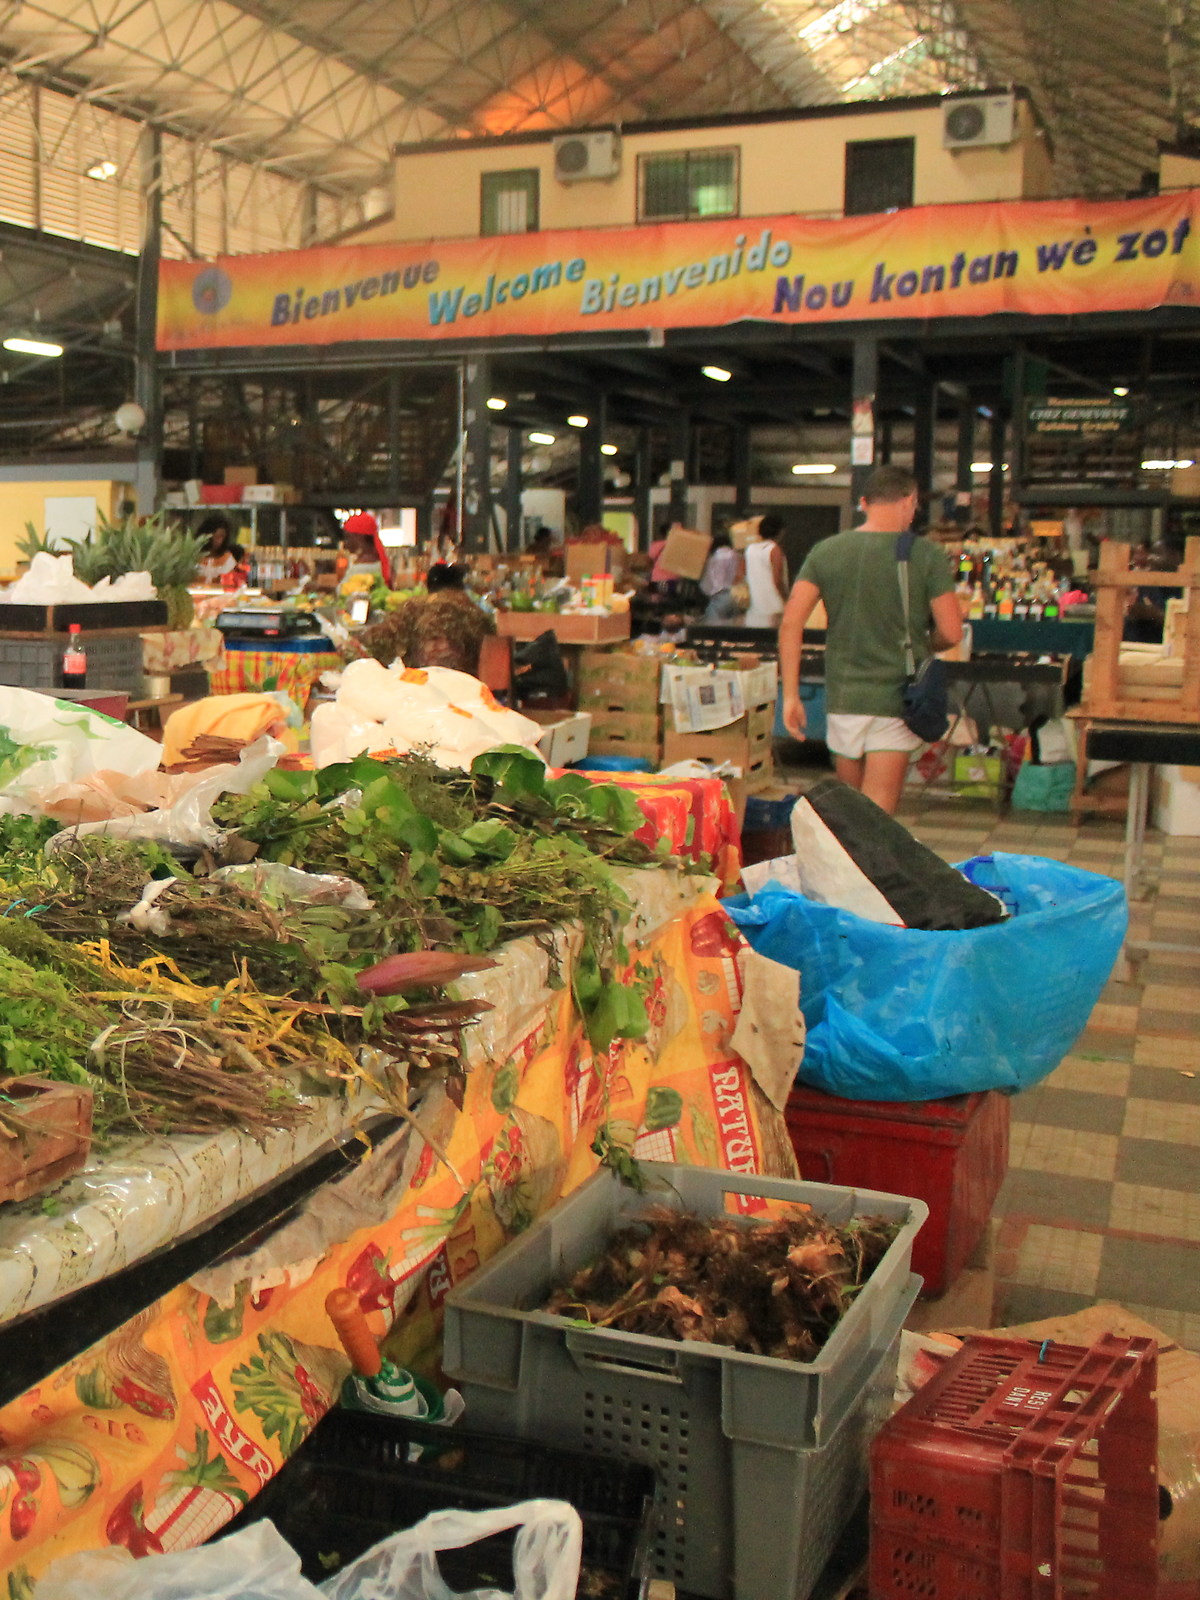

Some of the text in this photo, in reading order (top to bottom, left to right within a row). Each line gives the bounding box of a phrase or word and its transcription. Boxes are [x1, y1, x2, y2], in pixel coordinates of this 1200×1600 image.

[271, 260, 440, 327] Bienvenue
[428, 257, 586, 326] Welcome
[579, 231, 792, 316] Bienvenido
[773, 218, 1191, 313] Nou kontan wè zot
